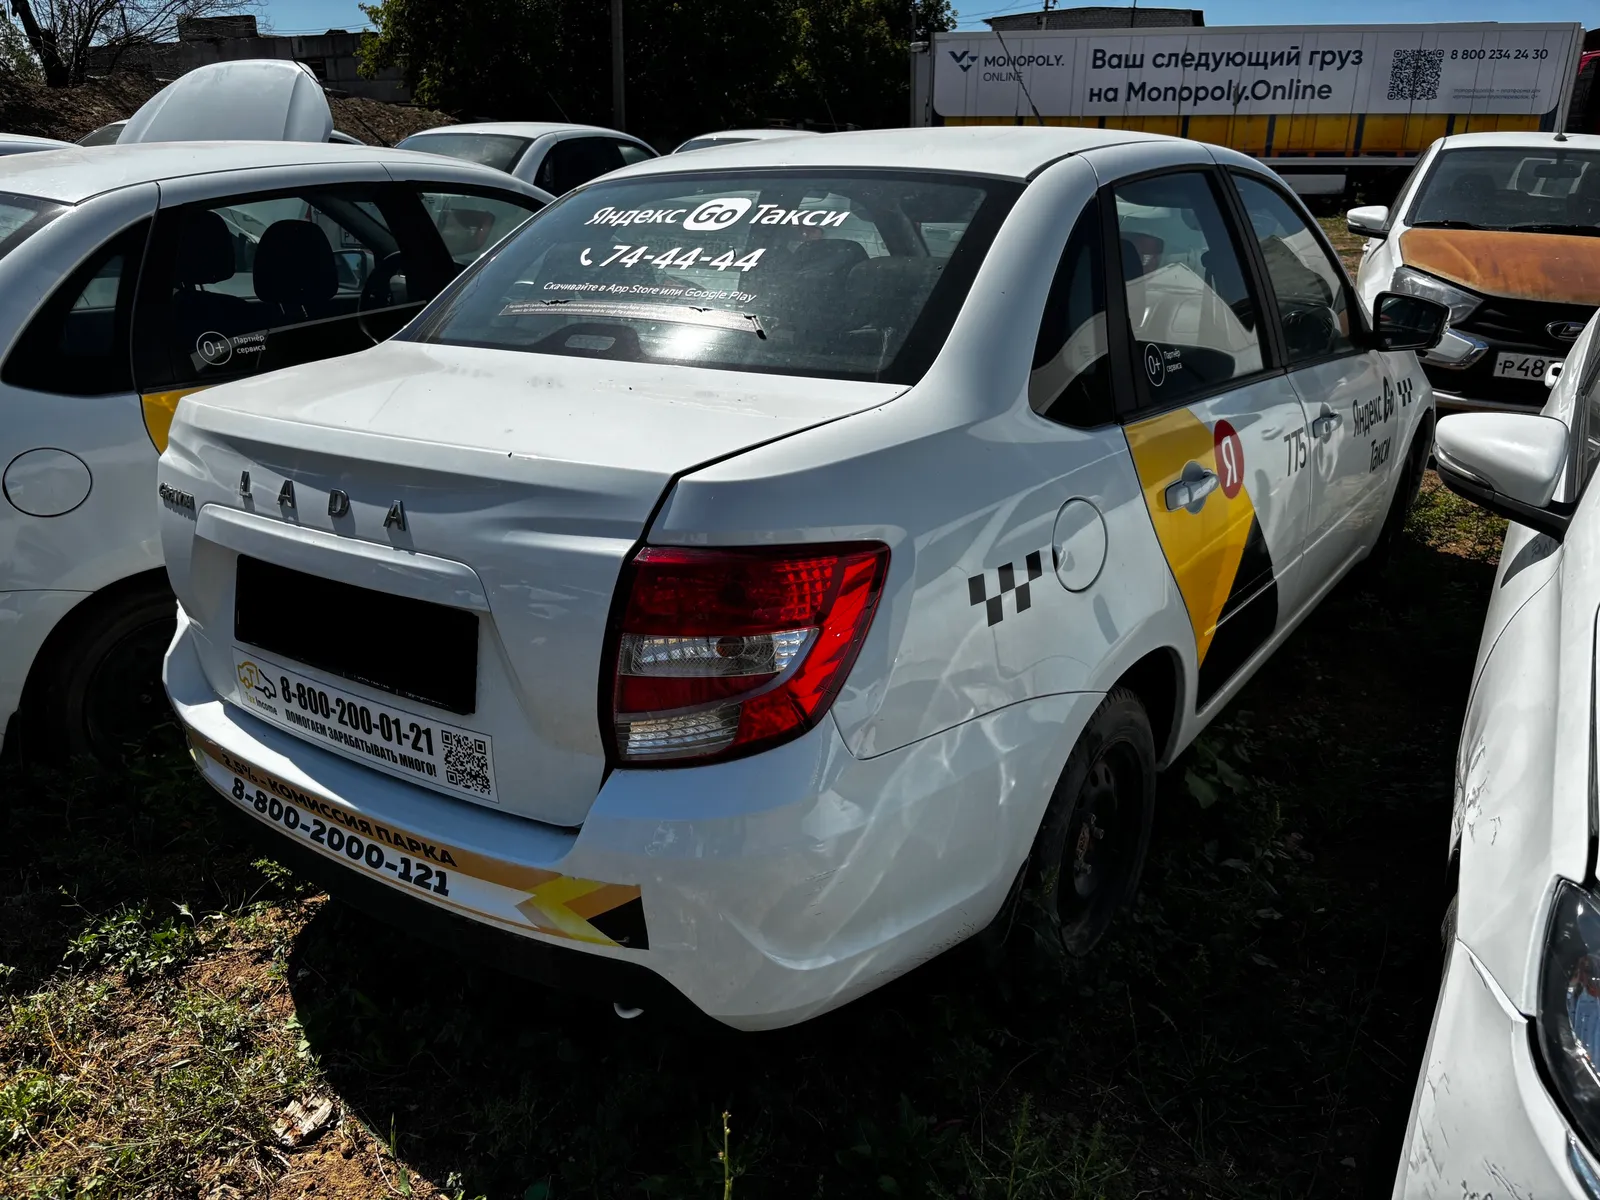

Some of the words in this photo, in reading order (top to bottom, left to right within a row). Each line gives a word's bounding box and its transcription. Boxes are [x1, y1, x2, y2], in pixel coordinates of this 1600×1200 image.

[984, 55, 1065, 68] MONOPOLY.
[1091, 49, 1144, 69] Ваш
[1152, 46, 1300, 73] следующий
[1309, 49, 1363, 71] груз
[1450, 50, 1458, 60] 8
[1461, 50, 1485, 60] 800
[1488, 49, 1511, 60] 234
[1514, 49, 1530, 60] 24
[1532, 49, 1548, 60] 30
[983, 72, 1023, 82] ONLINE
[1089, 86, 1118, 102] на
[1126, 80, 1332, 106] Monopoly.Online
[584, 206, 687, 227] Яндекс
[692, 202, 738, 223] Go
[749, 204, 850, 227] Такси
[599, 245, 766, 271] 74-44-44
[543, 282, 598, 292] Скачивайте
[606, 284, 628, 295] App
[629, 285, 659, 296] Store
[660, 287, 683, 296] или
[684, 288, 726, 300] Google
[728, 290, 757, 303] Play
[203, 341, 224, 356] 0+
[236, 344, 266, 354] сервиса
[1353, 399, 1382, 437] Яндекс
[1221, 435, 1238, 488] Я
[1284, 427, 1307, 476] 775
[1369, 436, 1391, 473] Такси
[239, 470, 406, 531] LADA
[280, 675, 434, 756] 8-800-200-01-21
[285, 708, 328, 738] ПОМОГАЕМ
[328, 727, 399, 764] ЗАРАБАТЫВАТЬ
[399, 752, 437, 777] МНОГО!
[267, 777, 374, 837] КОМИССИЯ
[375, 825, 458, 868] ПАРКА
[231, 777, 449, 896] 8-800-2000-121
